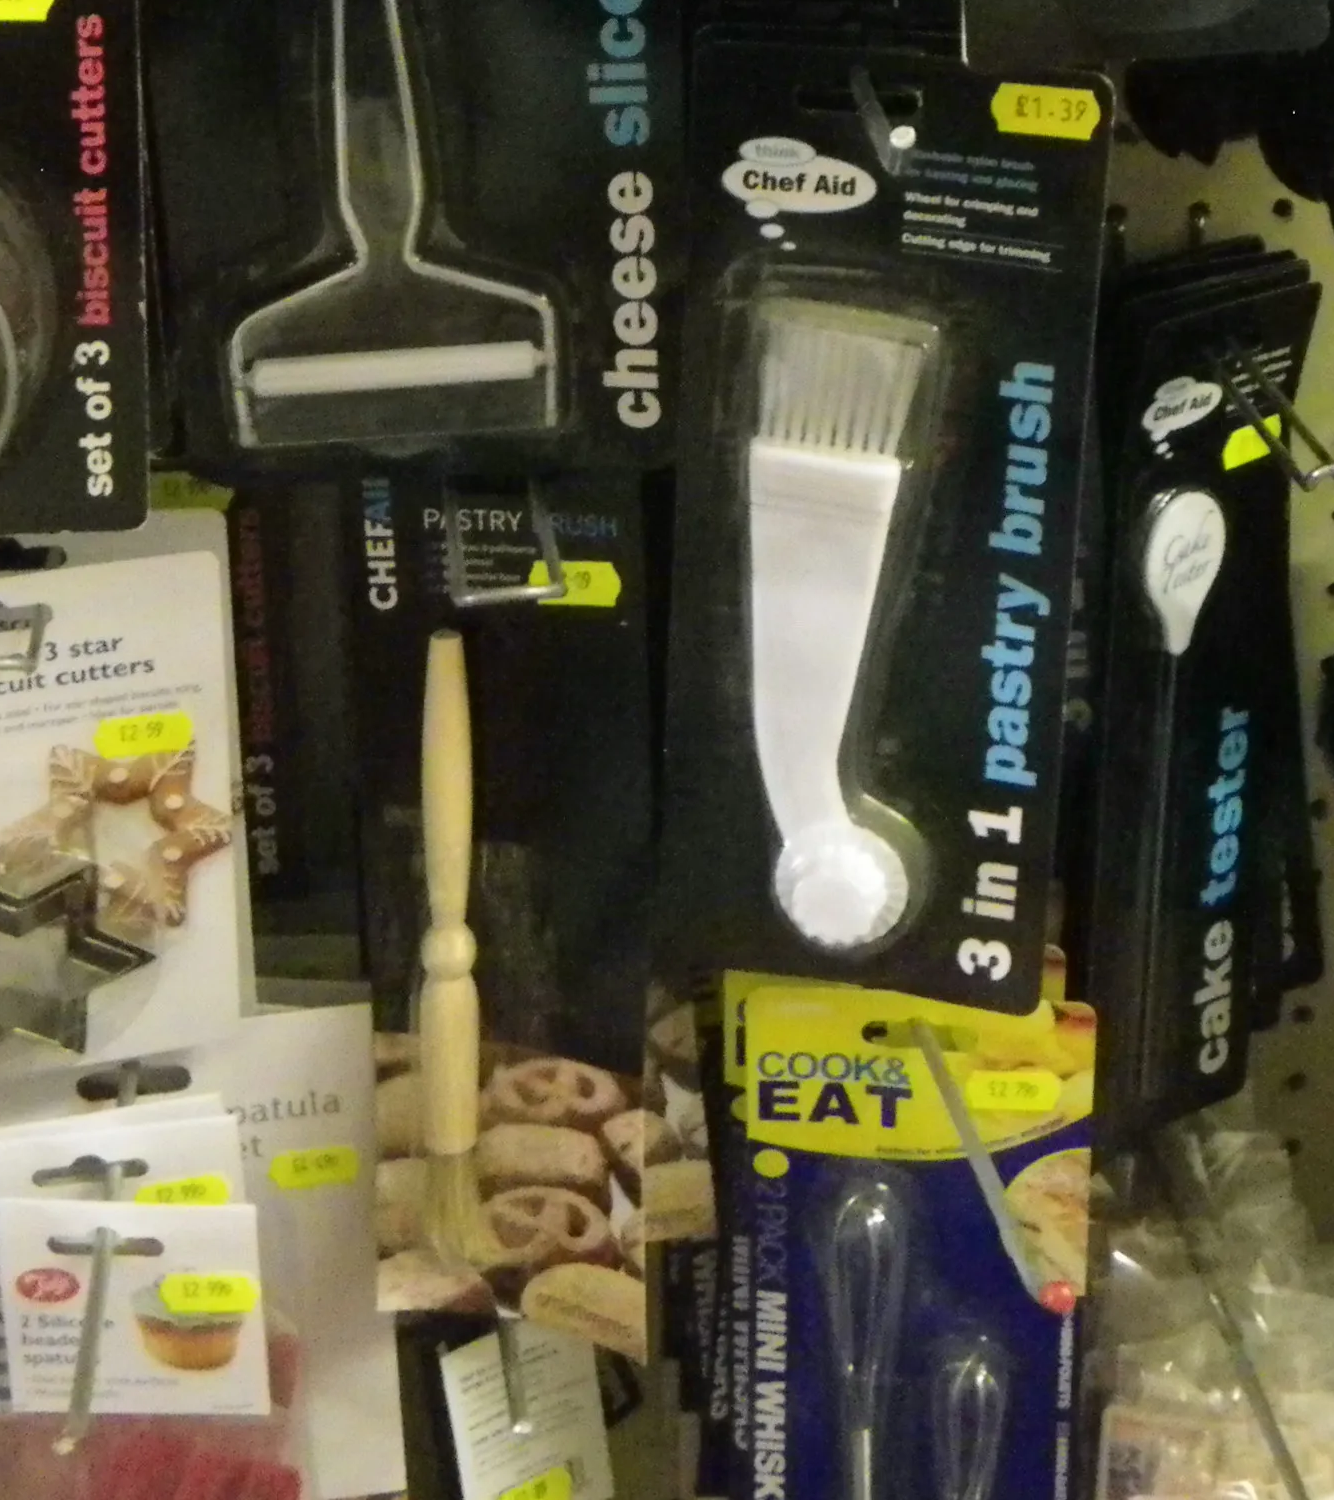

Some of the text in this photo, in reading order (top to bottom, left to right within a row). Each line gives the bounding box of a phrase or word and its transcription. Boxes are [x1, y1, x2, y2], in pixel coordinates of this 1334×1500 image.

[1015, 94, 1088, 123] £1.39
[742, 169, 857, 196] Chef Aid
[72, 12, 114, 497] set of 3 biscuit cutters
[902, 232, 946, 250] Cutting
[948, 239, 977, 253] edge
[998, 244, 1051, 264] trimming
[602, 171, 663, 430] cheese
[43, 636, 124, 662] 3 star
[55, 658, 155, 684] cutters
[957, 359, 1056, 982] 3 in 1 pastry brush
[1199, 706, 1250, 1076] cake tester
[756, 1080, 912, 1129] EAT
[754, 1290, 788, 1373] MINI
